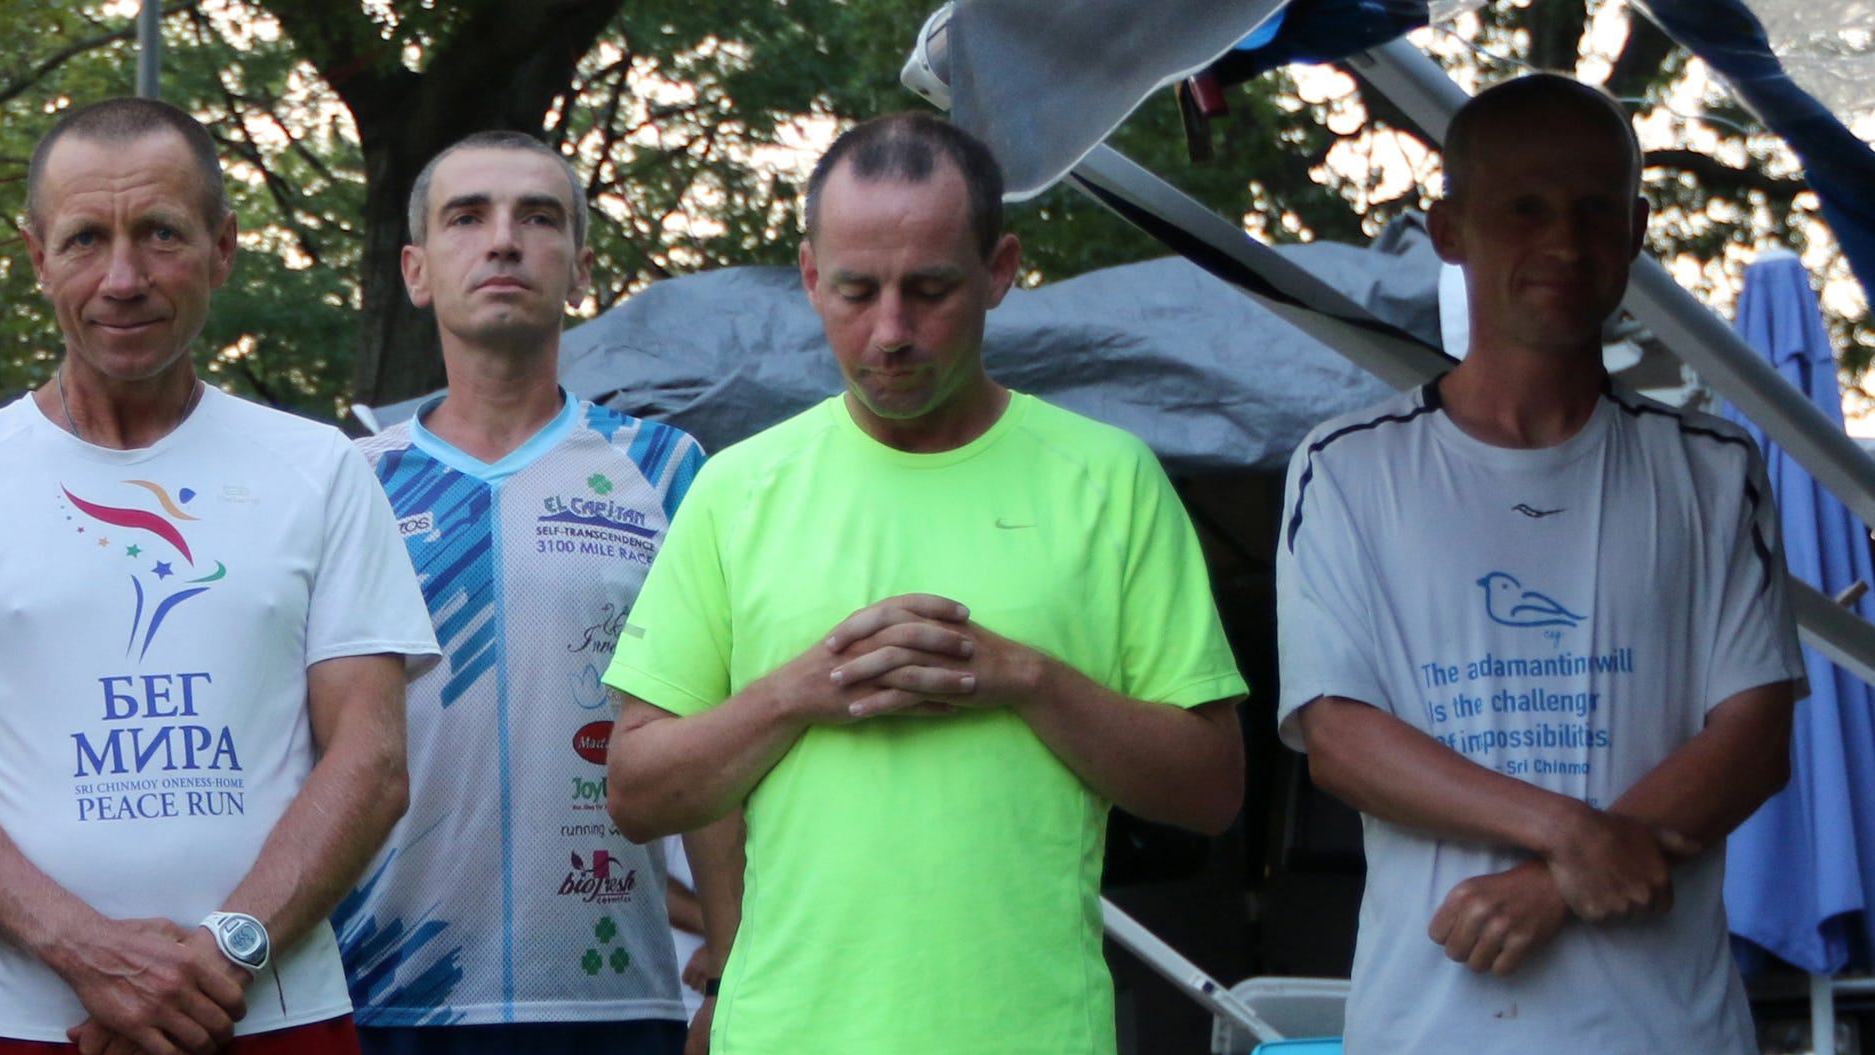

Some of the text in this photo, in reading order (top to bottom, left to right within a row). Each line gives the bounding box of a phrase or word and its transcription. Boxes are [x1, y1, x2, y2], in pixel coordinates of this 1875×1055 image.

[536, 526, 655, 552] SELF-TRANSCENDENCE
[537, 540, 653, 565] 3100 MILE RACE
[1421, 662, 1459, 689] The
[1596, 649, 1634, 674] will
[98, 672, 213, 721] БЕГ
[1453, 693, 1483, 719] the
[70, 725, 243, 777] МИРА
[1506, 759, 1528, 775] Sri
[1533, 758, 1591, 775] Chinmo
[75, 777, 244, 795] SRI CHINMOY ONENESS-HOME
[76, 790, 245, 822] PEACE RUN
[560, 824, 605, 839] running
